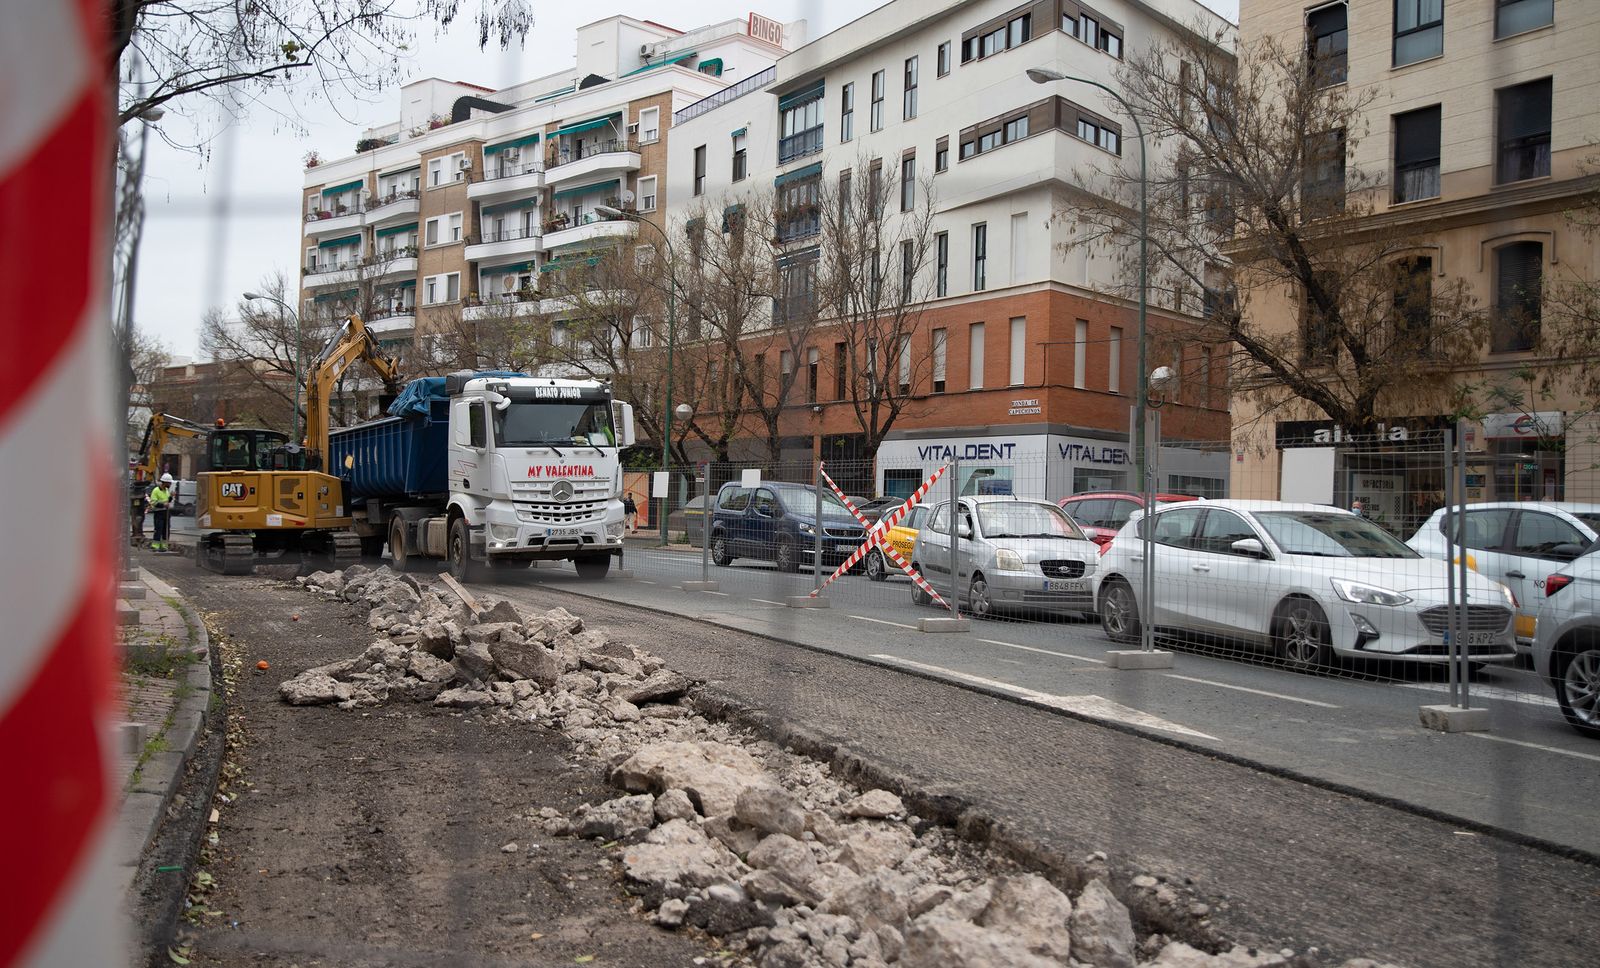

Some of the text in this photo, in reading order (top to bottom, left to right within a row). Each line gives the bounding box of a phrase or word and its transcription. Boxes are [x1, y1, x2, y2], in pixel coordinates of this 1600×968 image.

[752, 15, 781, 44] BINGO
[535, 387, 581, 398] RENATO JUNIOR
[918, 443, 1016, 461] VITALDENT
[1058, 443, 1133, 465] VITALDEN
[528, 465, 594, 478] MY VALENTINA
[222, 483, 242, 497] CAT
[893, 540, 914, 550] PROSEGU
